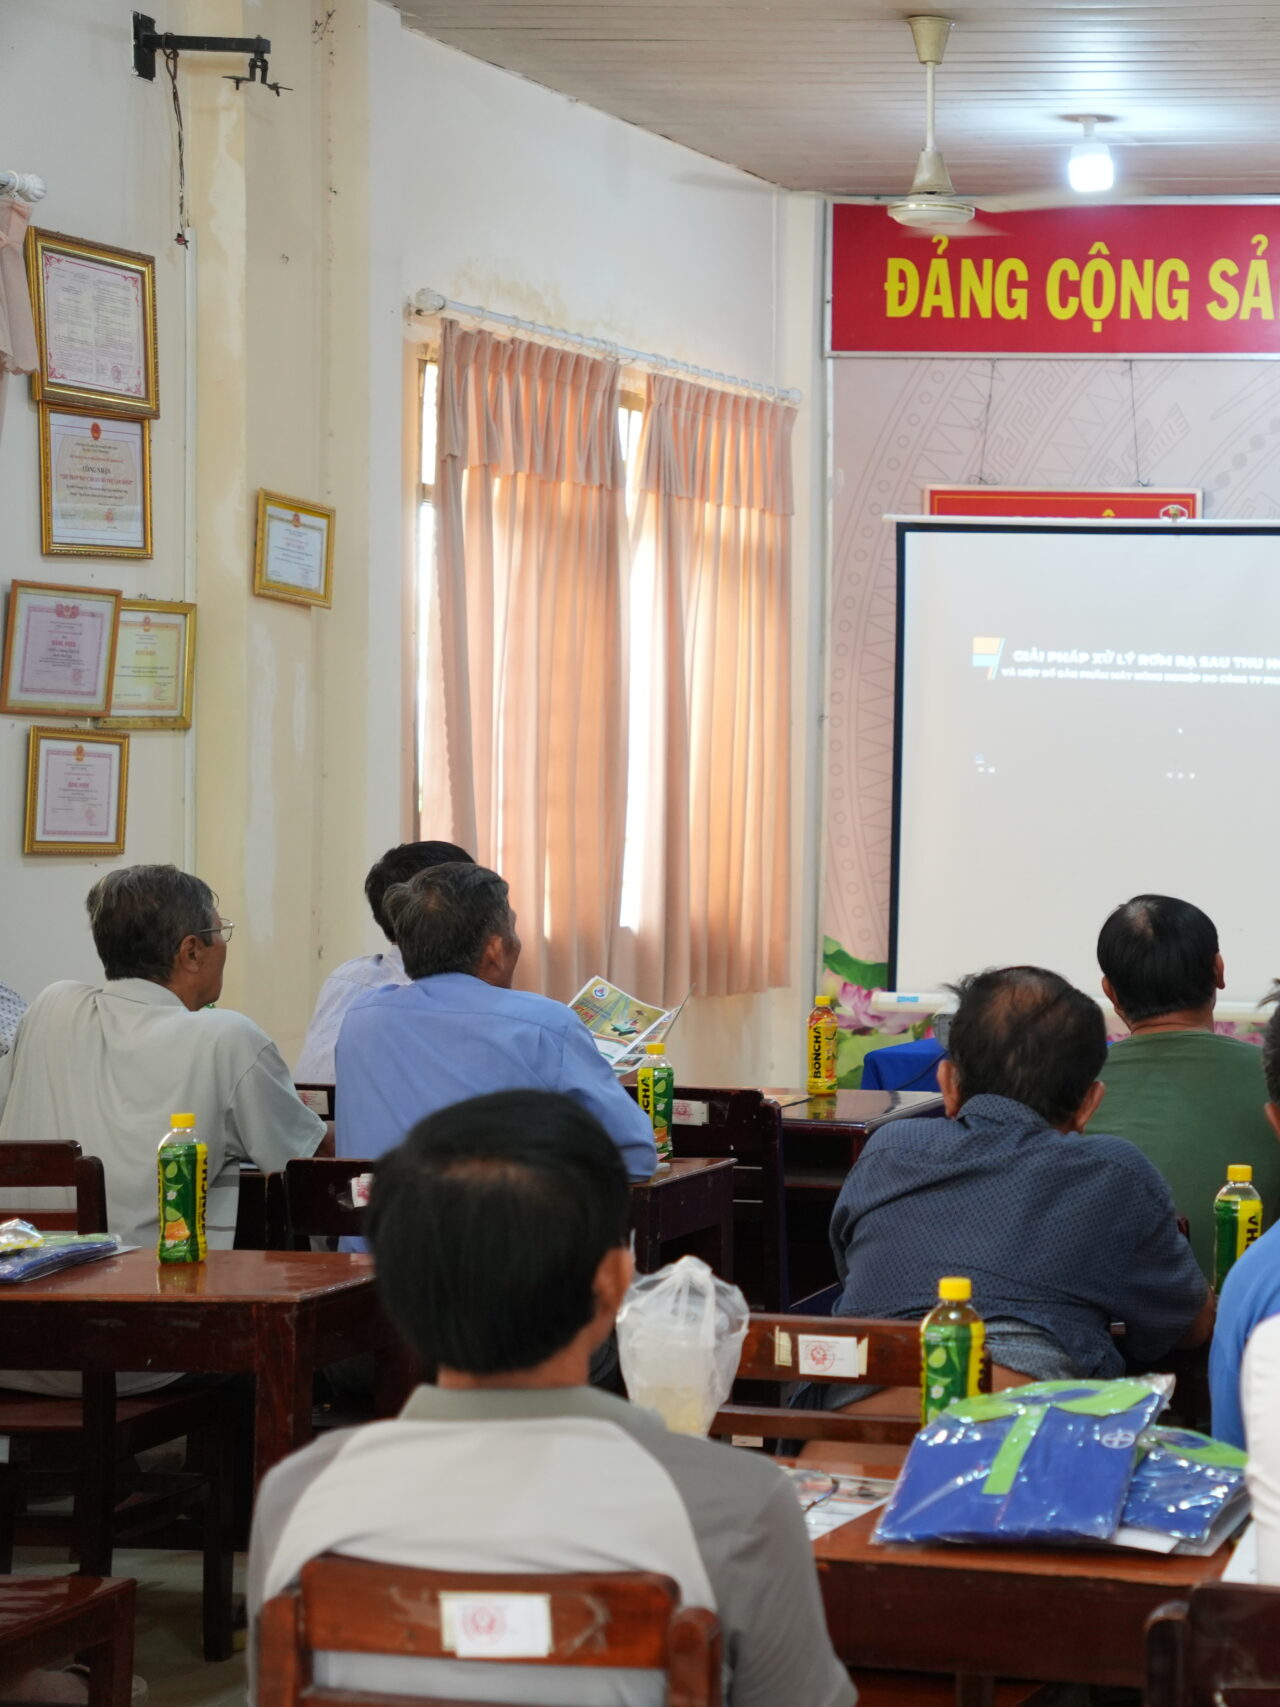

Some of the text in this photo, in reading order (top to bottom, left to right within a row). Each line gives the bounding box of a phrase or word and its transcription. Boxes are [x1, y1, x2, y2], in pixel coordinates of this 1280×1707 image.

[885, 235, 1029, 320] ĐẢNG
[1045, 242, 1190, 333] CỘNG
[1047, 649, 1090, 664] PHÁP
[813, 1025, 822, 1079] BONCHA
[641, 1076, 650, 1114] CHA
